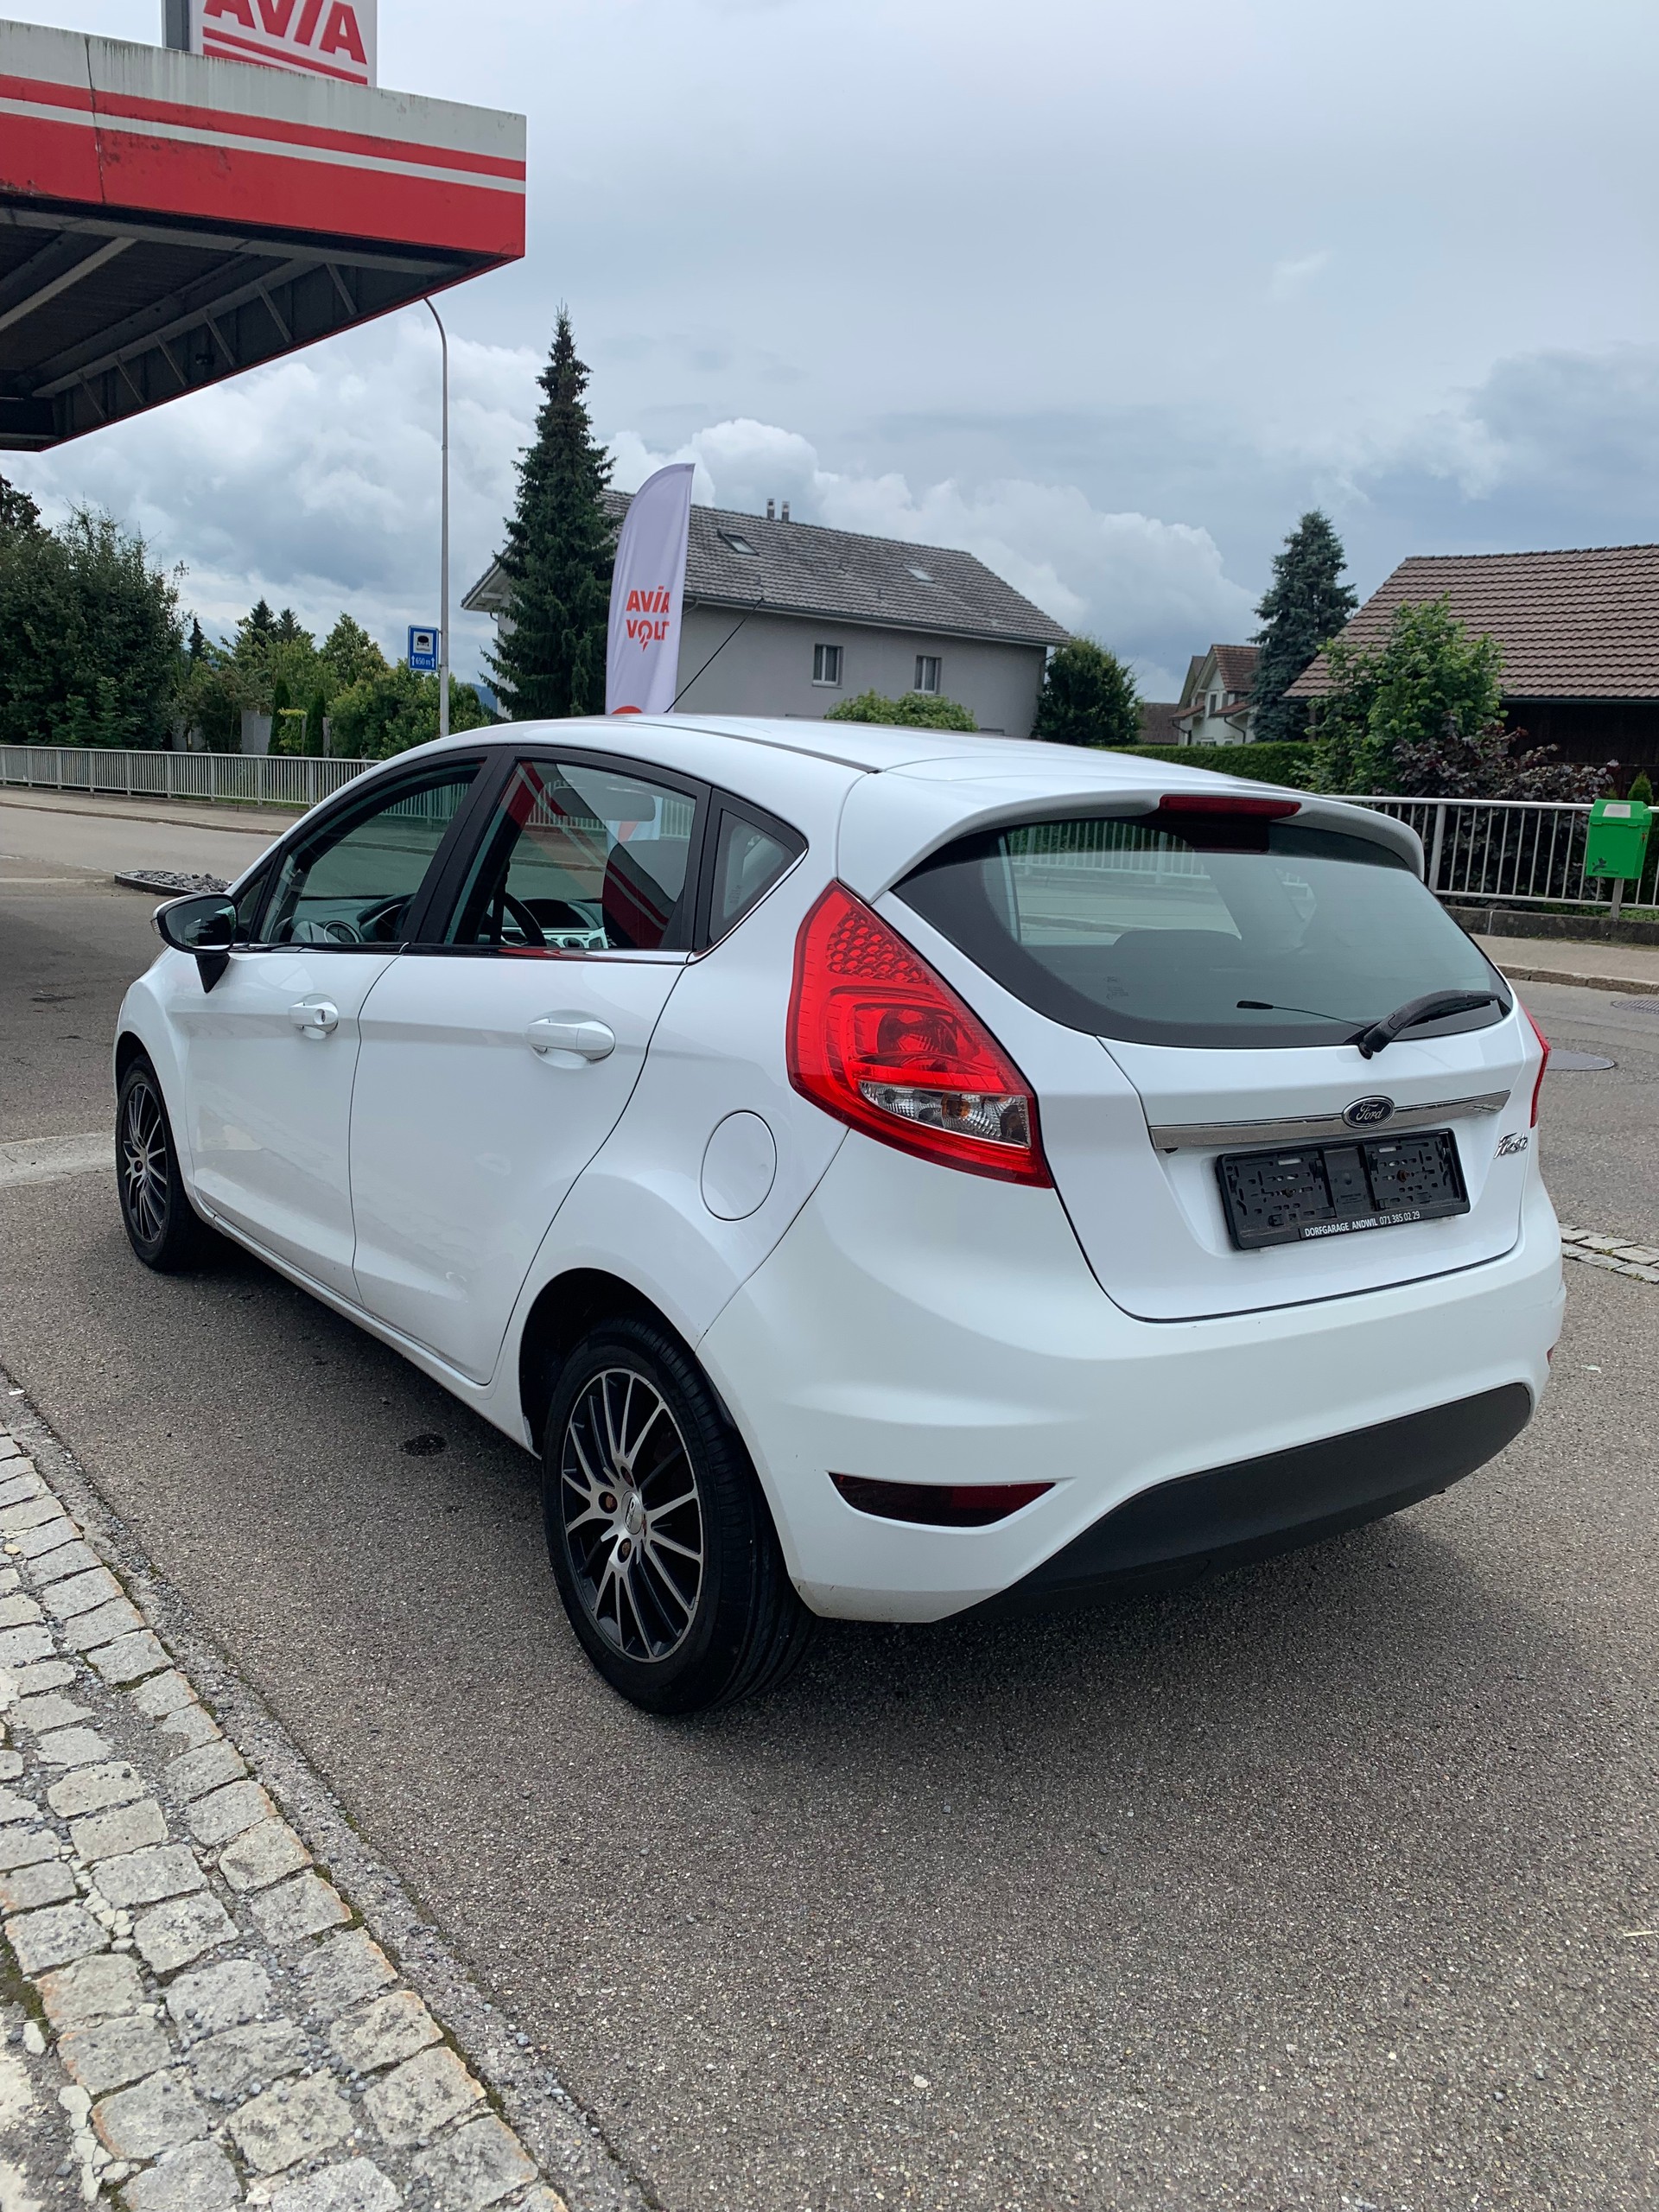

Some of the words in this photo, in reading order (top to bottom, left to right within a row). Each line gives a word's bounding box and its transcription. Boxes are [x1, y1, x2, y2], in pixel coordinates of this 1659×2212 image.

[626, 586, 671, 613] AVIA
[626, 619, 670, 652] VOLT
[416, 657, 425, 665] 650
[1356, 1103, 1384, 1122] Ford
[1304, 1222, 1350, 1236] DORFGARAGE
[1351, 1217, 1378, 1229] ANDWIL
[1379, 1216, 1391, 1225] 071
[1391, 1213, 1403, 1224] 385
[1403, 1211, 1412, 1221] 02
[1412, 1211, 1421, 1220] 29
